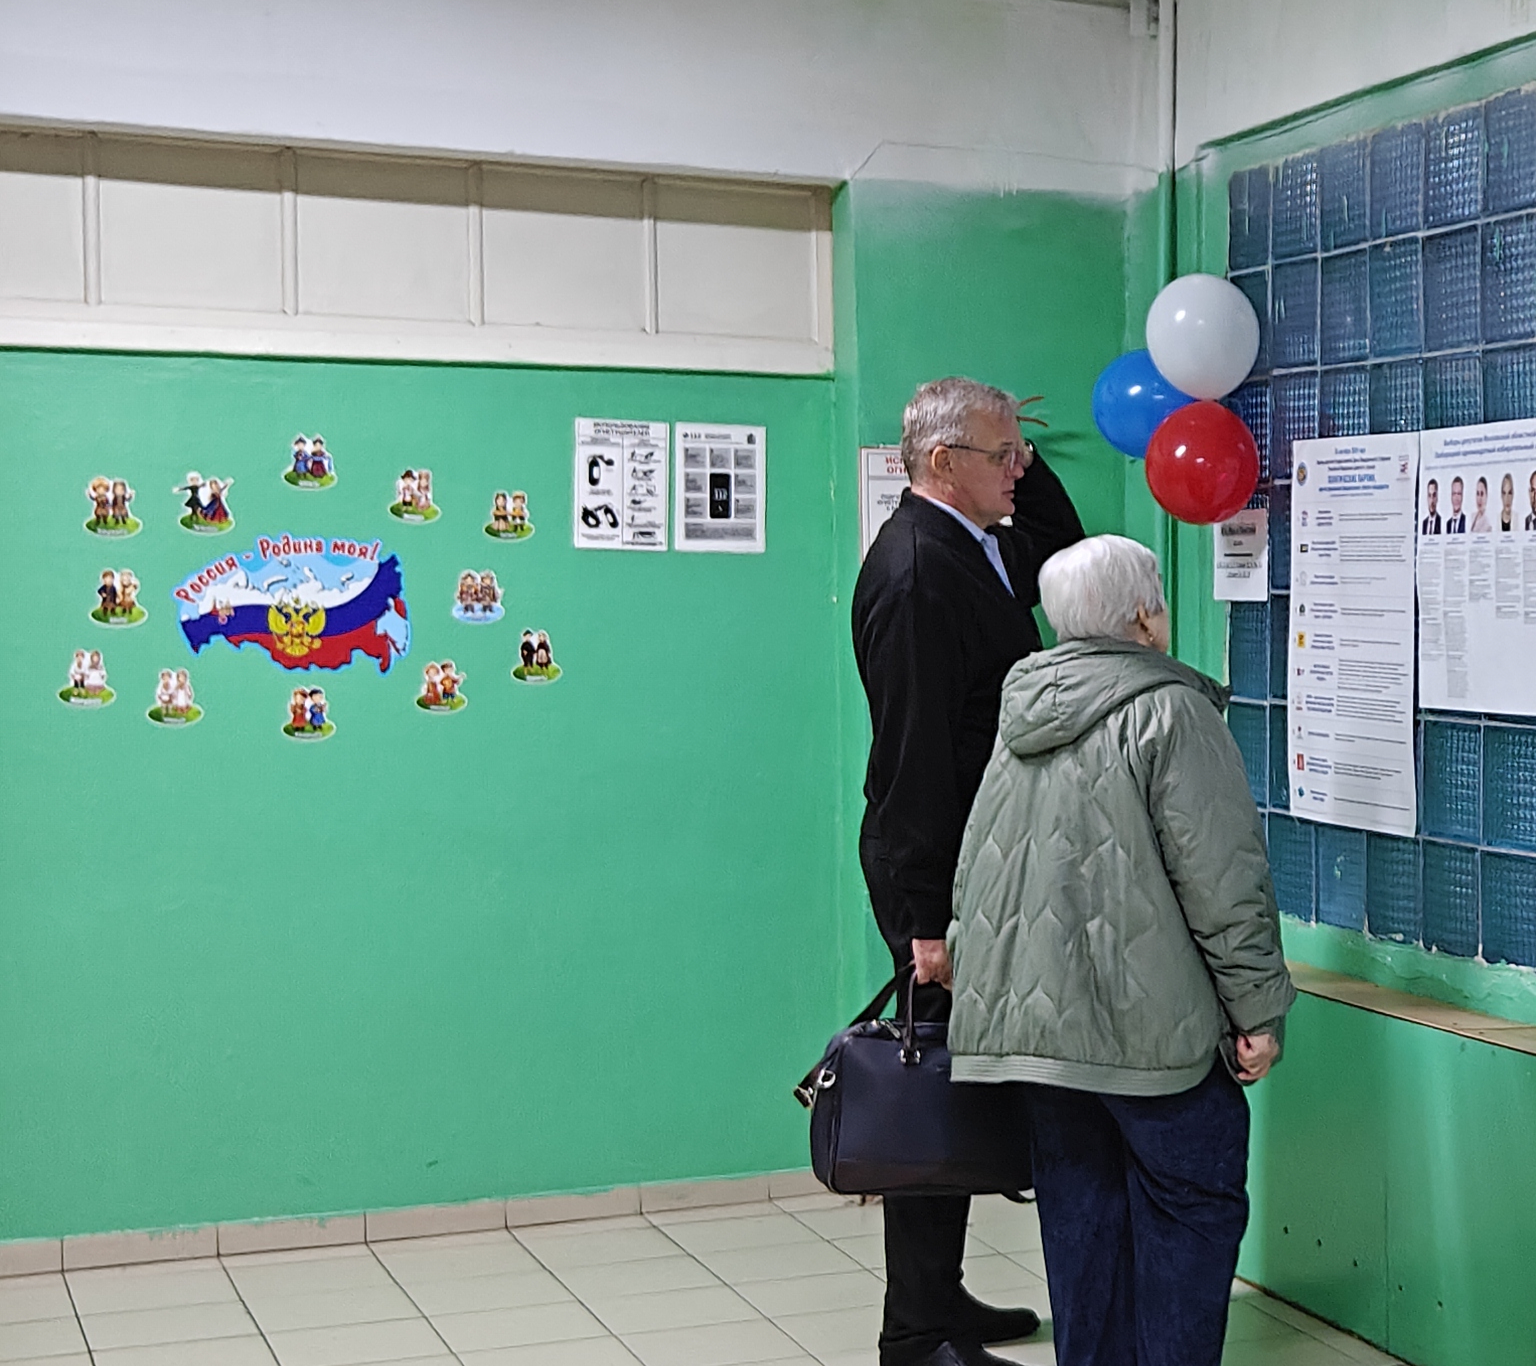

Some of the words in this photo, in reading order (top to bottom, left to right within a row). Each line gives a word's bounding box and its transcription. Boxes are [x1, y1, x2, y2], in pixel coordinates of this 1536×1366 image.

[175, 555, 238, 604] Россия
[258, 534, 324, 561] Родина
[331, 539, 381, 561] моя!
